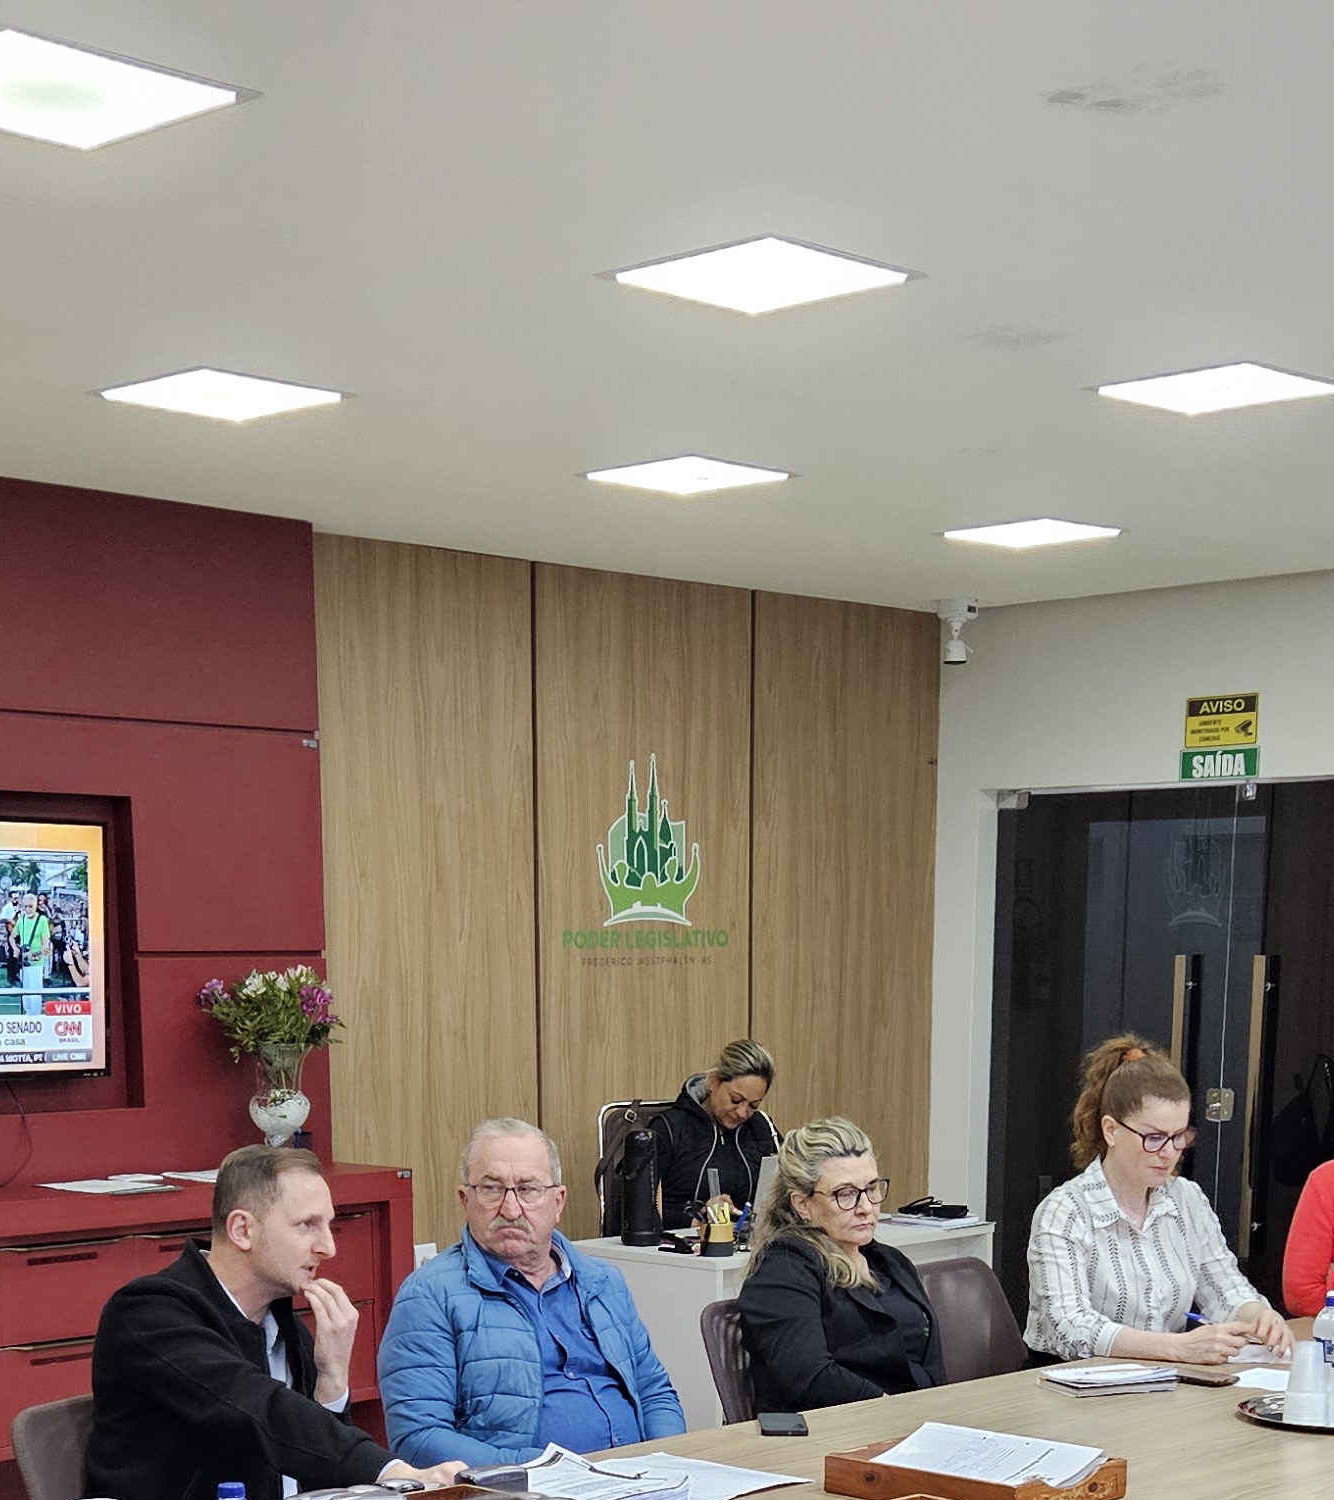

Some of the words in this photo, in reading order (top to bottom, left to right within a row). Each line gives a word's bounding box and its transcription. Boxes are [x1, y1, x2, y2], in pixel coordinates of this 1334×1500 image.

[1199, 698, 1245, 715] AVISO
[1192, 750, 1245, 778] SAÍDA
[563, 930, 620, 949] PODER
[625, 929, 729, 948] LEGISLATIVO
[581, 956, 633, 966] FREDERICO
[54, 1004, 81, 1014] VIVO
[7, 1021, 42, 1034] SENADO
[54, 1021, 82, 1036] CNN
[5, 1038, 25, 1046] casa
